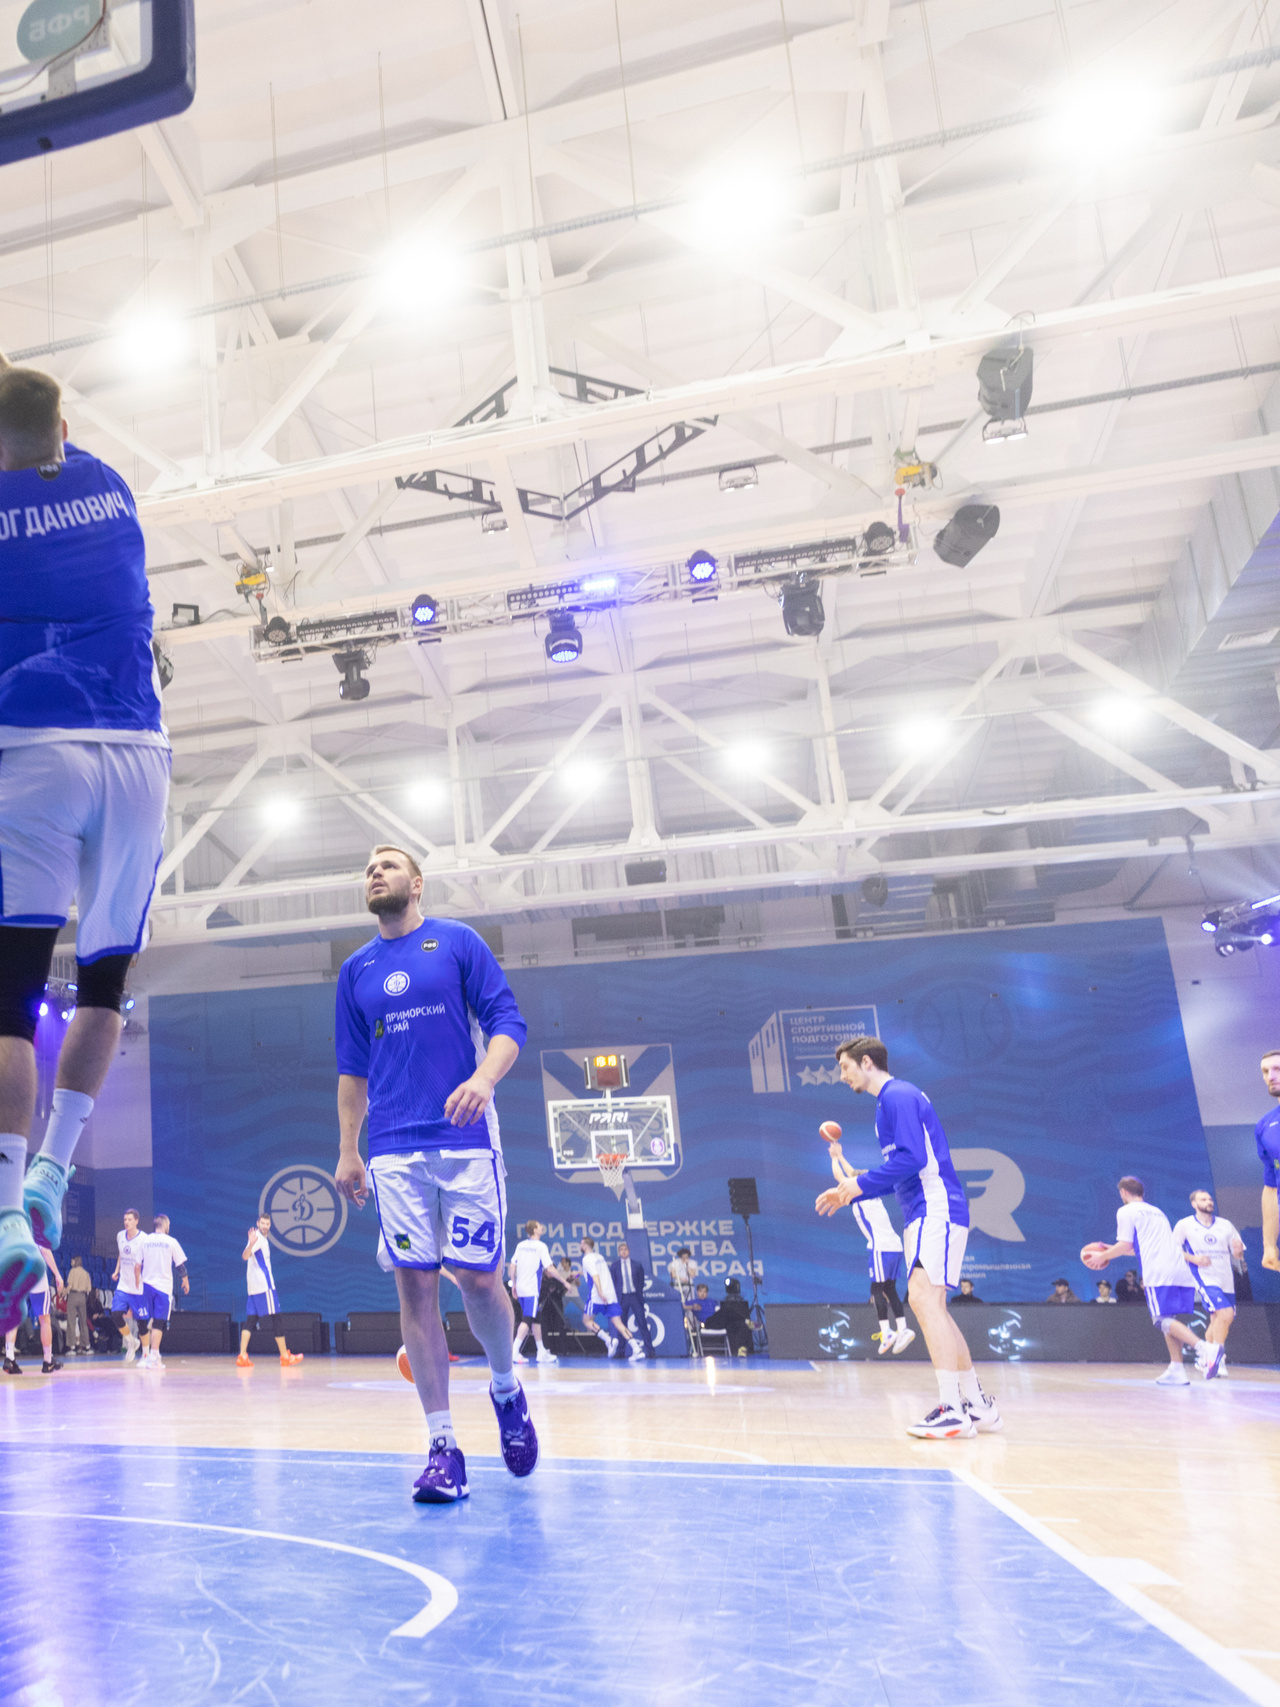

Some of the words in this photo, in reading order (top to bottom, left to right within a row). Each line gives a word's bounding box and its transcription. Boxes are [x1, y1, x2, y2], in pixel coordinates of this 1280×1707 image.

[385, 1003, 446, 1024] ПРИМОРСКИЙ
[387, 1020, 410, 1034] КРАЙ
[790, 1016, 826, 1026] ЦЕНТР
[791, 1021, 865, 1034] СПОРТИВНОЙ
[589, 1111, 629, 1124] PARI
[451, 1215, 496, 1253] 54
[572, 1220, 734, 1240] ПОДЕРЖКЕ
